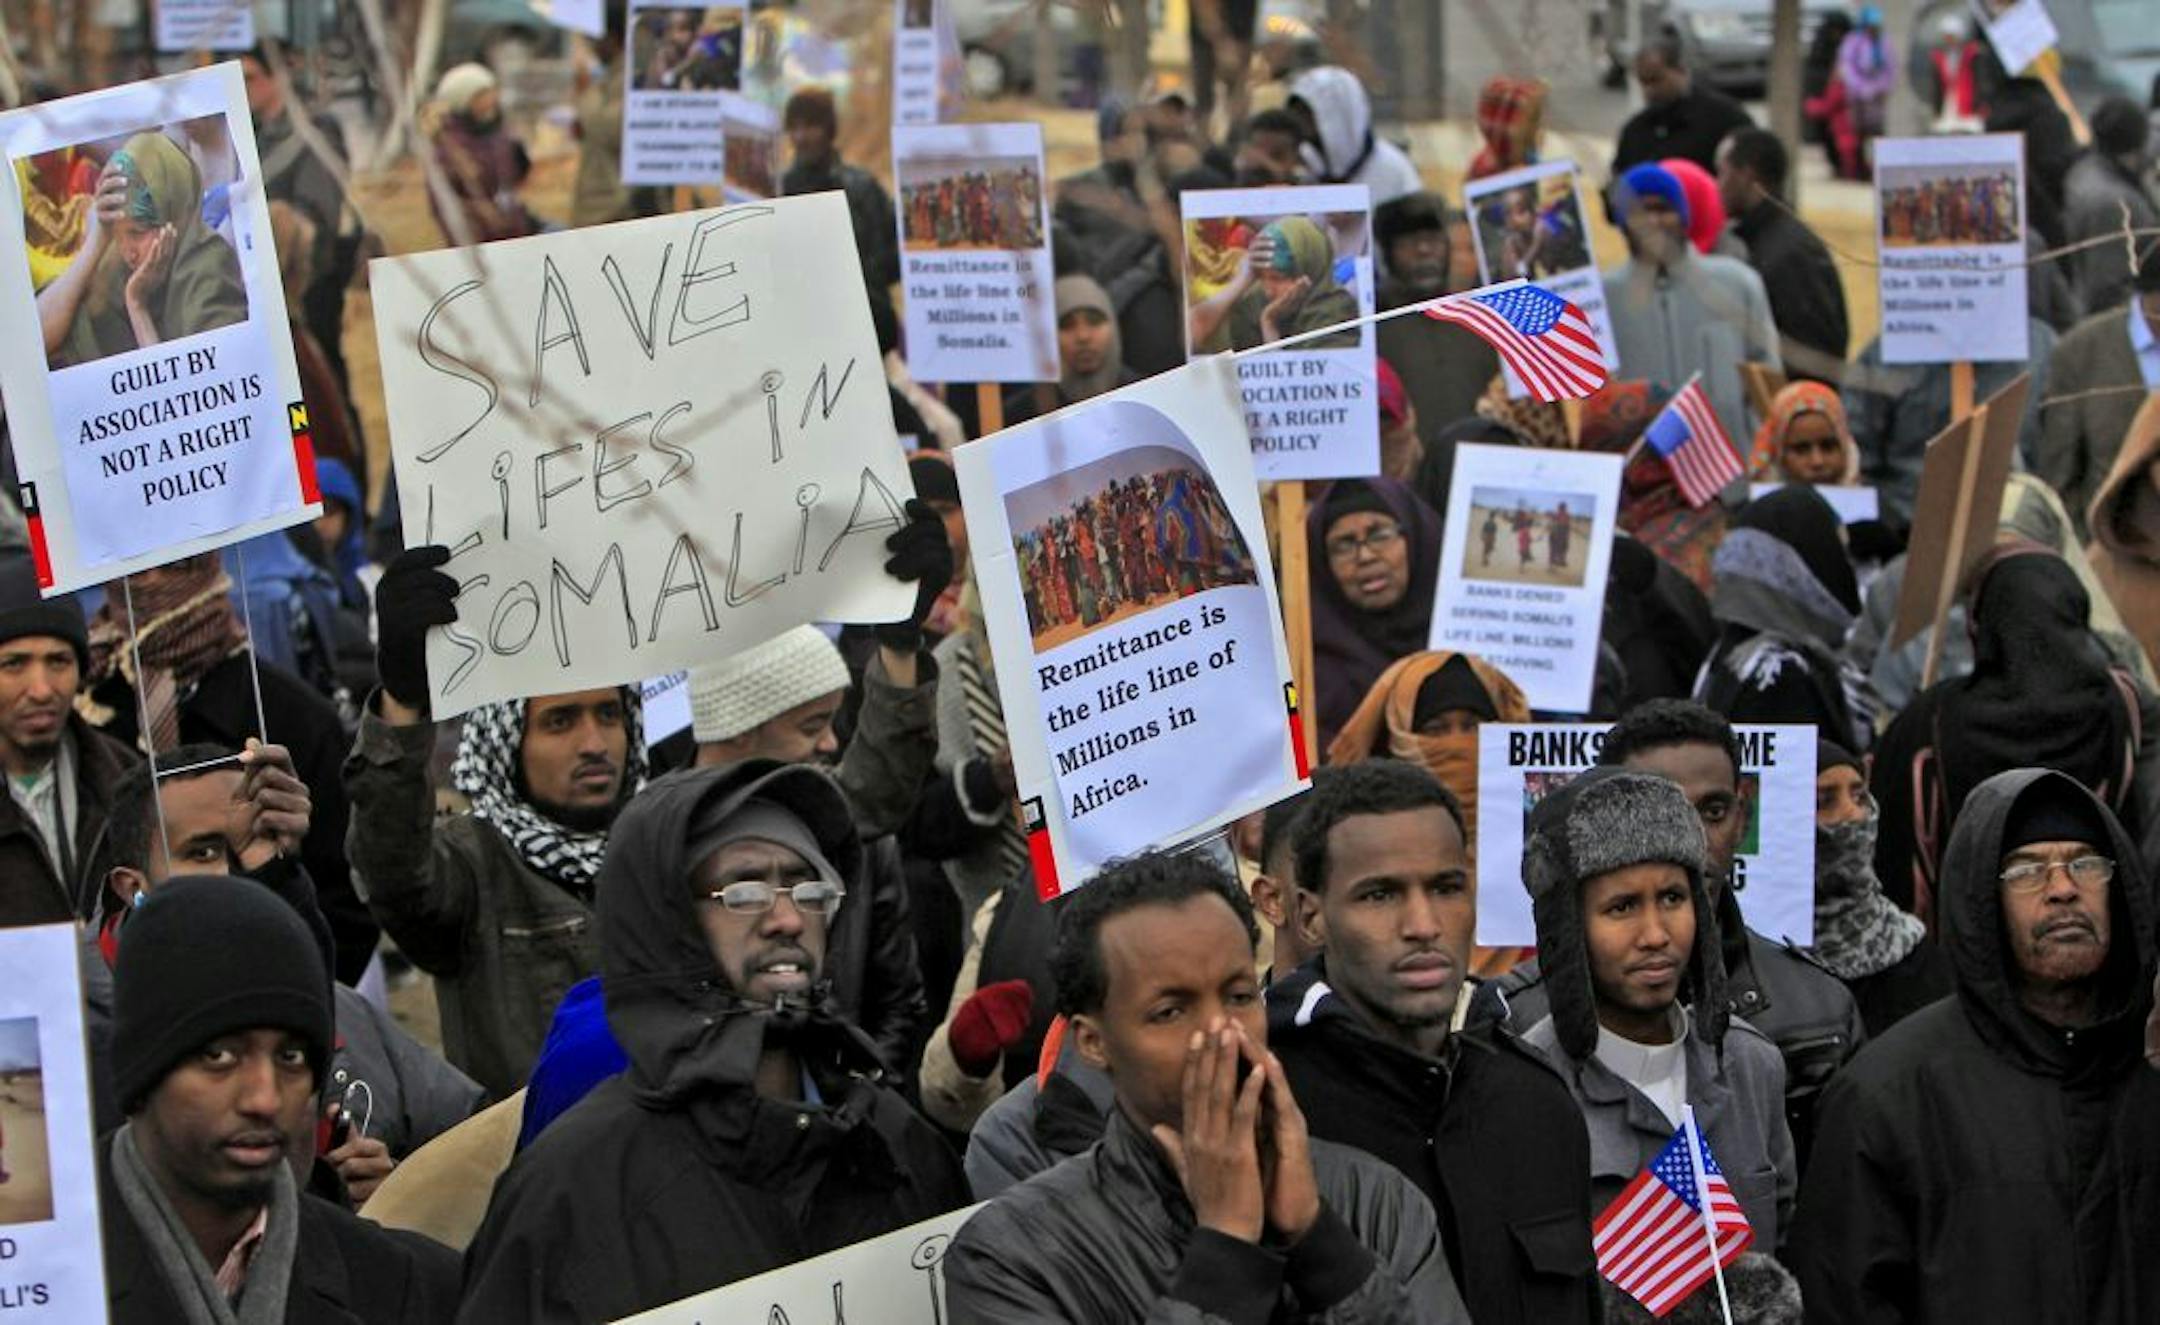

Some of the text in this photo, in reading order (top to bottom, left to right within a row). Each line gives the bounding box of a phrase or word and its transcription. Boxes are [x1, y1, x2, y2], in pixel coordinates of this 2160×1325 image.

[910, 259, 1010, 274] Remittance
[911, 283, 1037, 299] the life line of
[416, 206, 774, 463] SAVE
[927, 308, 1021, 325] Millions in
[110, 346, 218, 396] GUILT BY
[1237, 359, 1327, 378] GUILT BY
[1344, 382, 1361, 398] IS
[78, 373, 263, 446] ASSOCIATION IS
[1268, 411, 1280, 427] A
[1286, 408, 1347, 426] RIGHT
[100, 415, 253, 478] NOT A RIGHT
[1251, 434, 1321, 454] POLICY
[142, 462, 228, 507] POLICY
[1467, 586, 1511, 600] BANKS
[1038, 604, 1227, 691] Remittance is
[1047, 639, 1237, 733] the life line of
[1056, 705, 1198, 777] Millions in
[1070, 772, 1149, 820] Africa.
